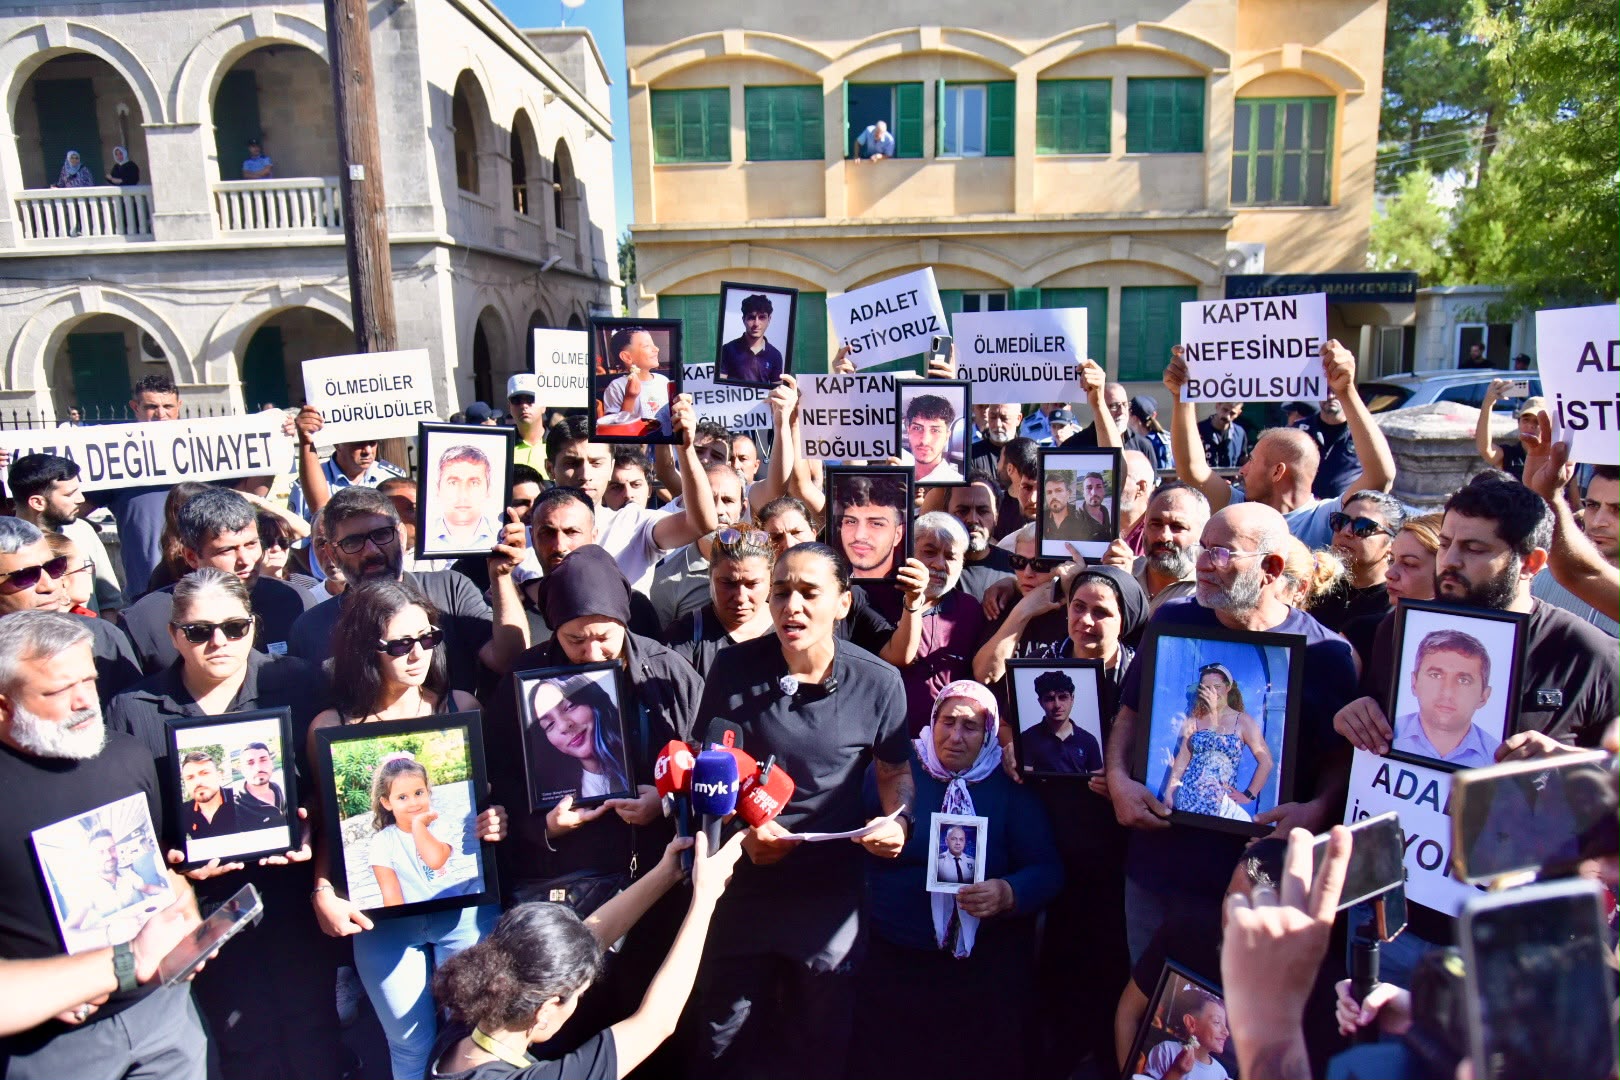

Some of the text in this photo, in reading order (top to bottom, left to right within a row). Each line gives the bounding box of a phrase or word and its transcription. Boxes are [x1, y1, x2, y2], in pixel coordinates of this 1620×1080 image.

[850, 289, 918, 324] ADALET
[1202, 299, 1298, 324] KAPTAN
[844, 315, 940, 356] İSTİYORUZ
[974, 332, 1066, 354] ÖLMEDİLER
[1186, 334, 1320, 362] NEFESİNDE
[325, 373, 413, 396] ÖLMEDİLER
[815, 374, 895, 394] KAPTAN
[1186, 372, 1320, 399] BOĞULSUN
[322, 399, 434, 424] LDÜRÜLDÜLER
[86, 429, 167, 482] DEĞİL
[172, 427, 272, 474] CİNAYET
[694, 781, 729, 797] myk
